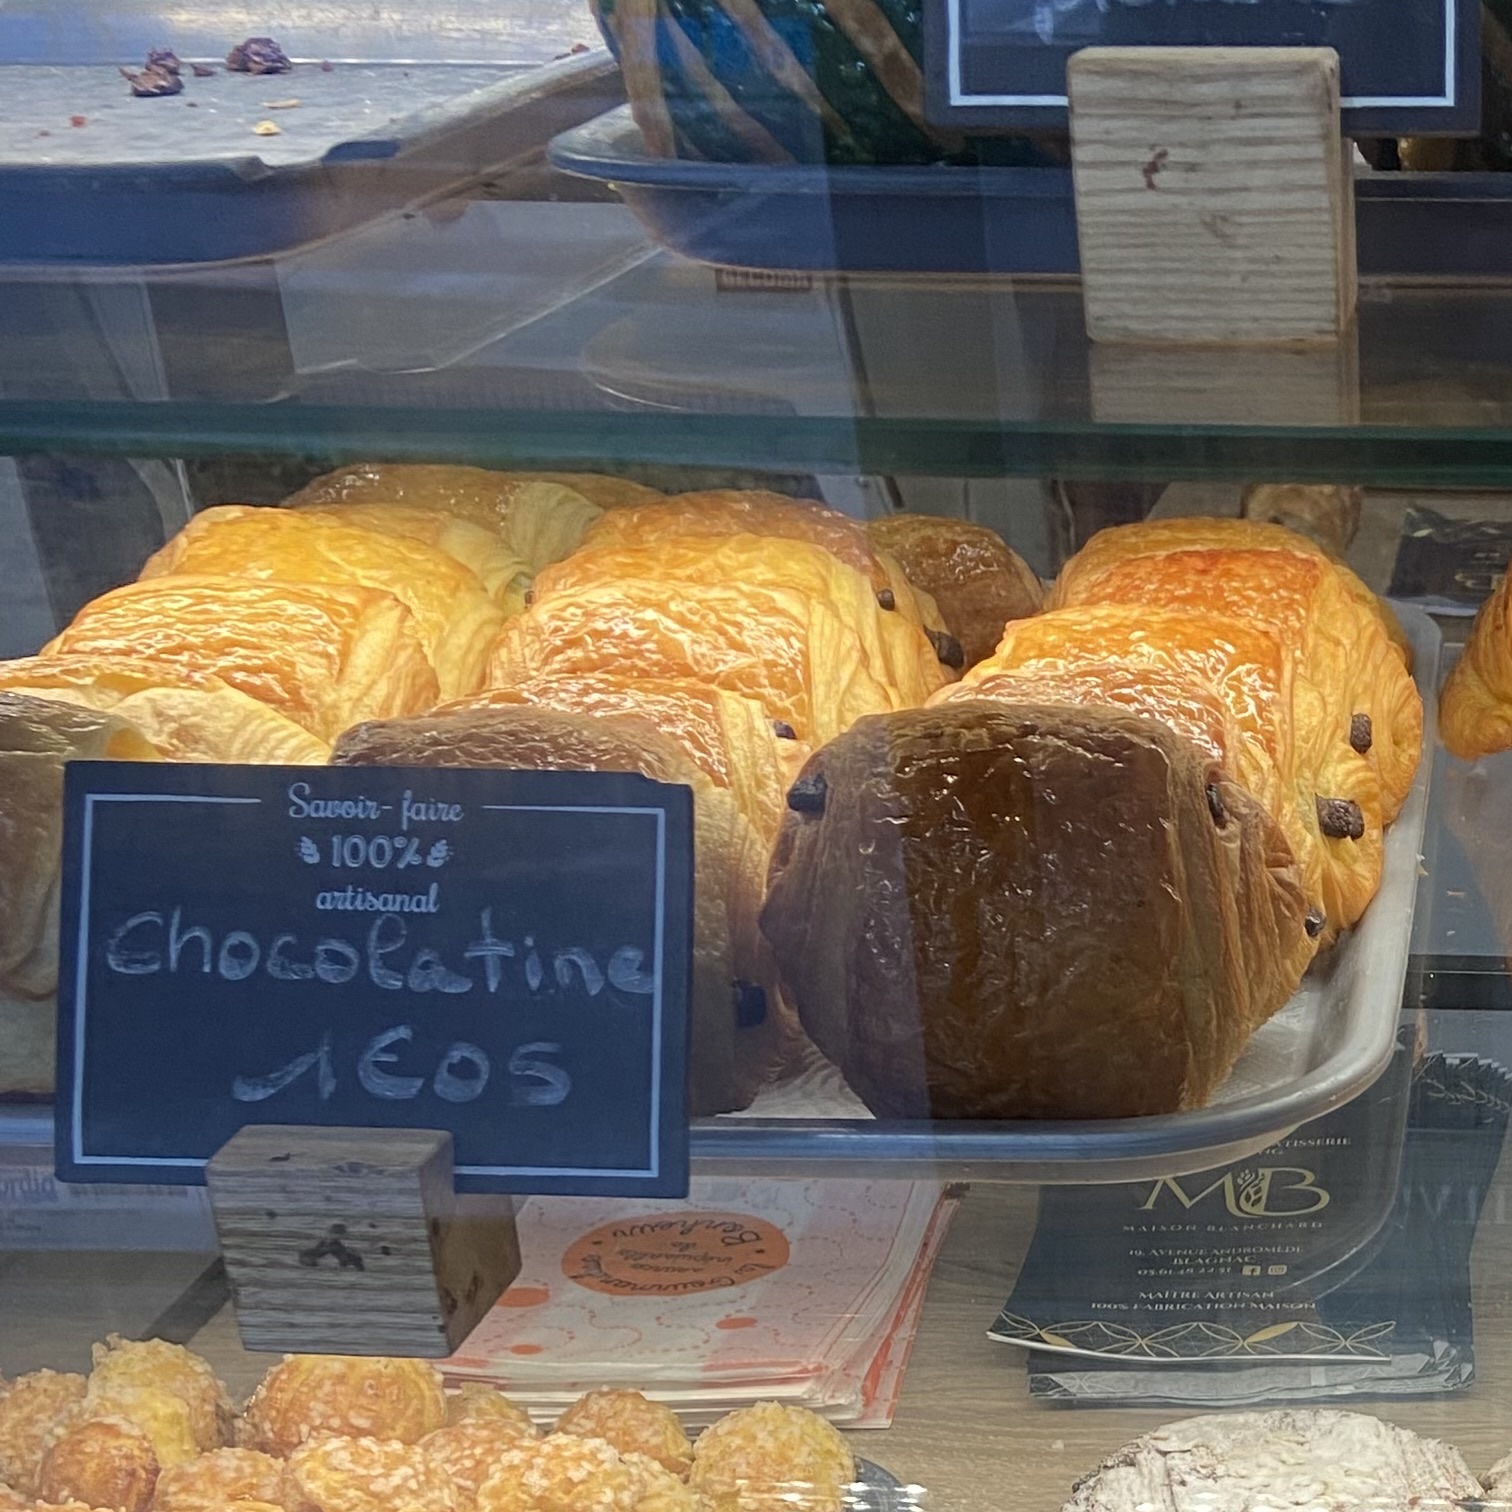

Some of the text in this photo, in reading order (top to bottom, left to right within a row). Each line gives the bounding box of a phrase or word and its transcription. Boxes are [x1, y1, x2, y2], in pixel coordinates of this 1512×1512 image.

[331, 835, 422, 870] 100%
[316, 883, 440, 914] artisanal
[106, 906, 654, 997] Chocolatine
